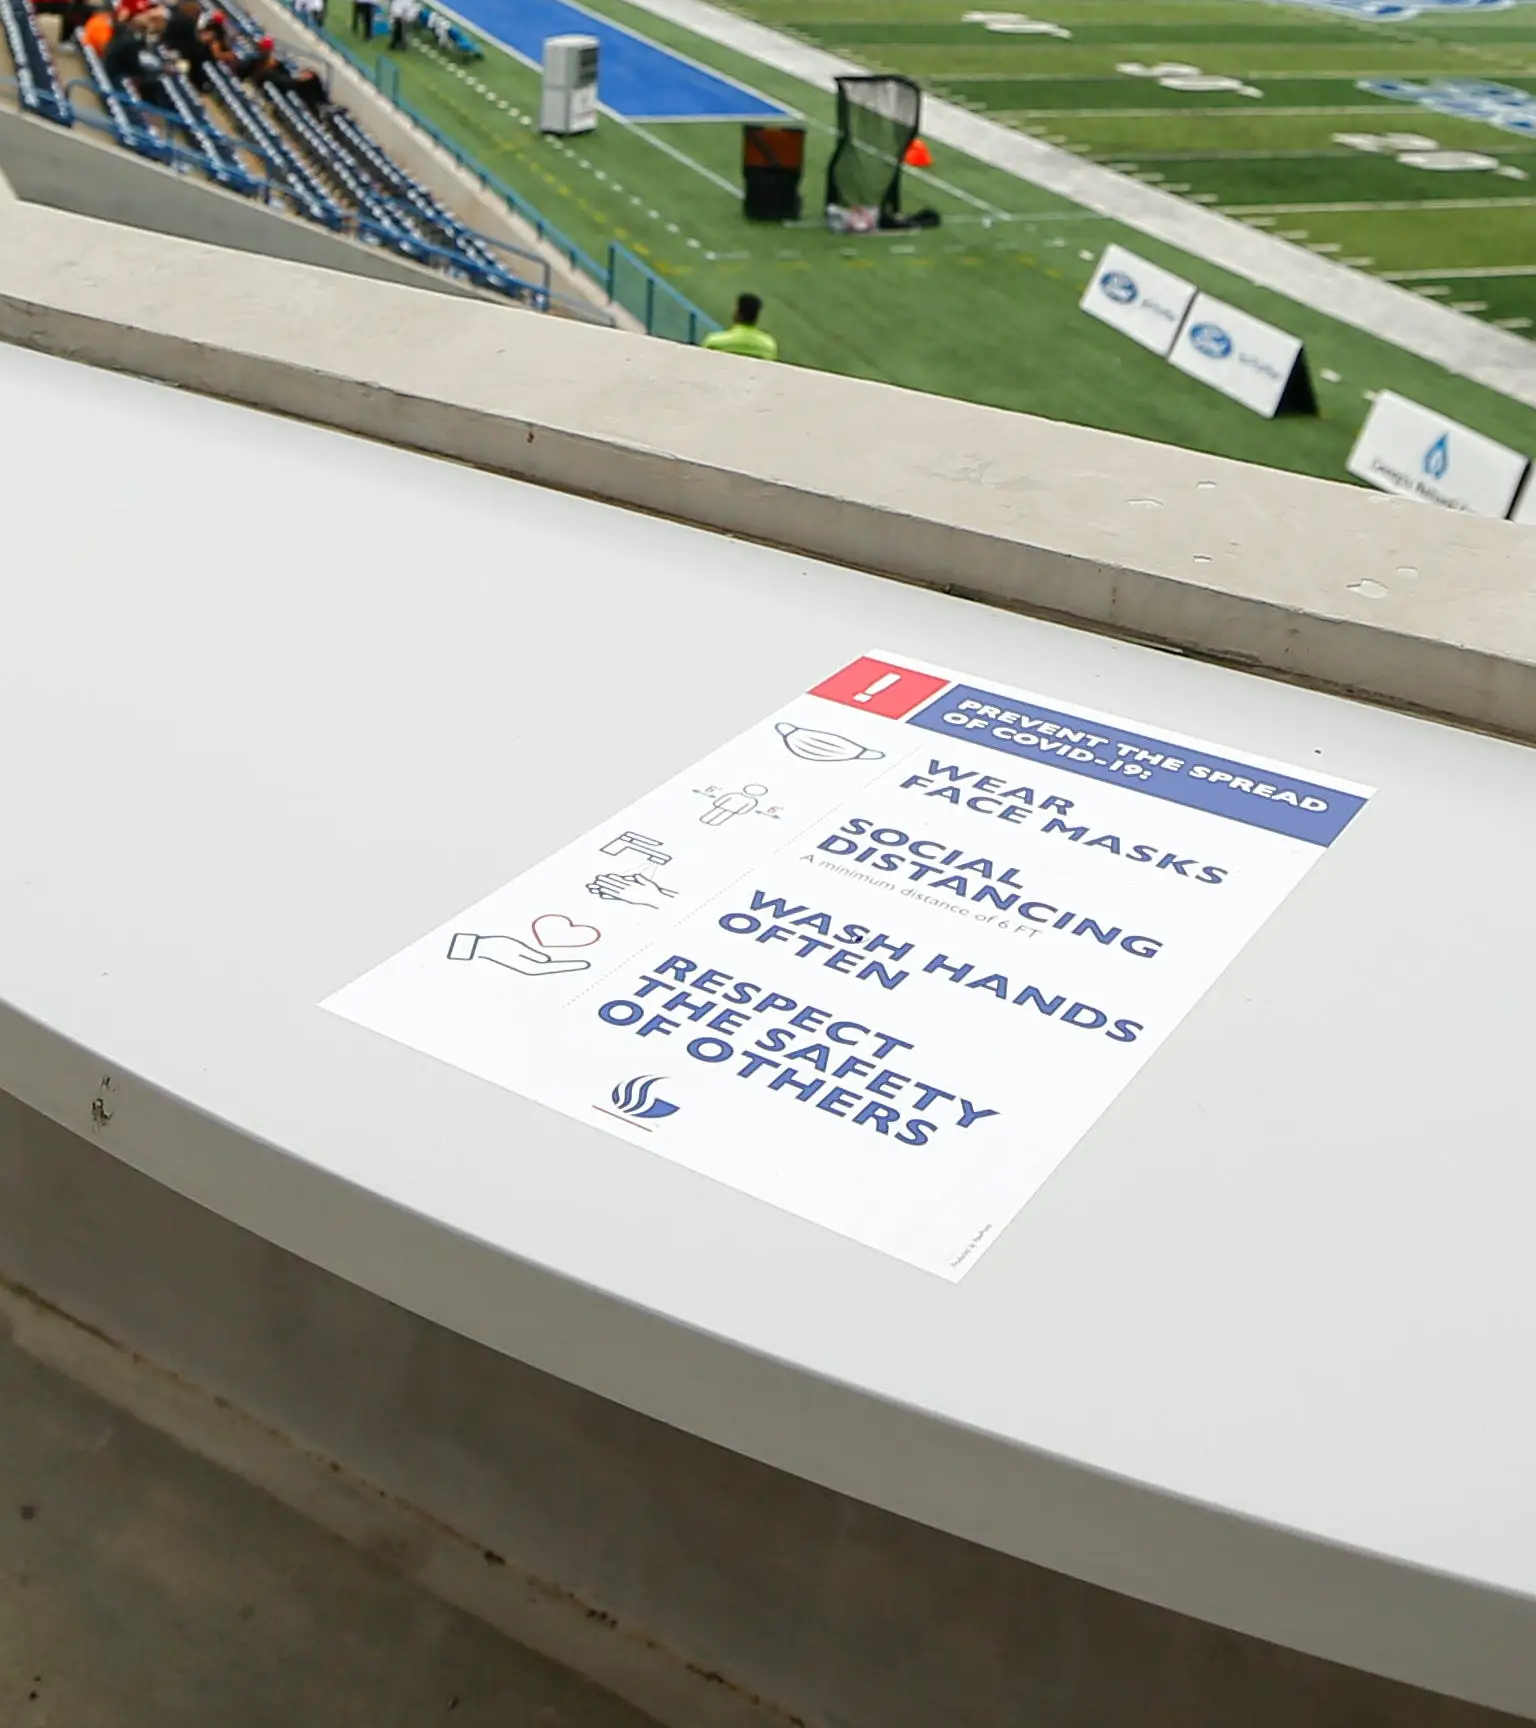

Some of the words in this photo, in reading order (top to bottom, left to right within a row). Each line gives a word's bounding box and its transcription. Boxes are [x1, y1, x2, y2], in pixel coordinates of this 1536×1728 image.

[927, 758, 1075, 816] WEAR
[943, 712, 989, 732] OF
[994, 726, 1153, 781] COVID-19:
[958, 699, 1109, 750] PREVENT
[1117, 743, 1184, 771] THE
[1188, 764, 1329, 815] SPREAD
[840, 818, 1024, 890] SOCIAL
[900, 774, 1035, 826] FACE
[1041, 817, 1228, 886] MASKS
[799, 853, 816, 864] A
[818, 859, 896, 892] minimum
[900, 886, 971, 917] distance
[974, 909, 997, 925] of
[1013, 925, 1044, 939] FT
[816, 834, 1164, 959] DISTANCING
[717, 912, 911, 991] OFTEN
[748, 890, 916, 962] WASH
[921, 954, 1146, 1044] HANDS
[633, 975, 753, 1036] THE
[753, 1027, 1002, 1130] SAFETY
[654, 955, 915, 1060] RESPECT
[597, 999, 682, 1040] OF
[685, 1036, 939, 1148] OTHERS
